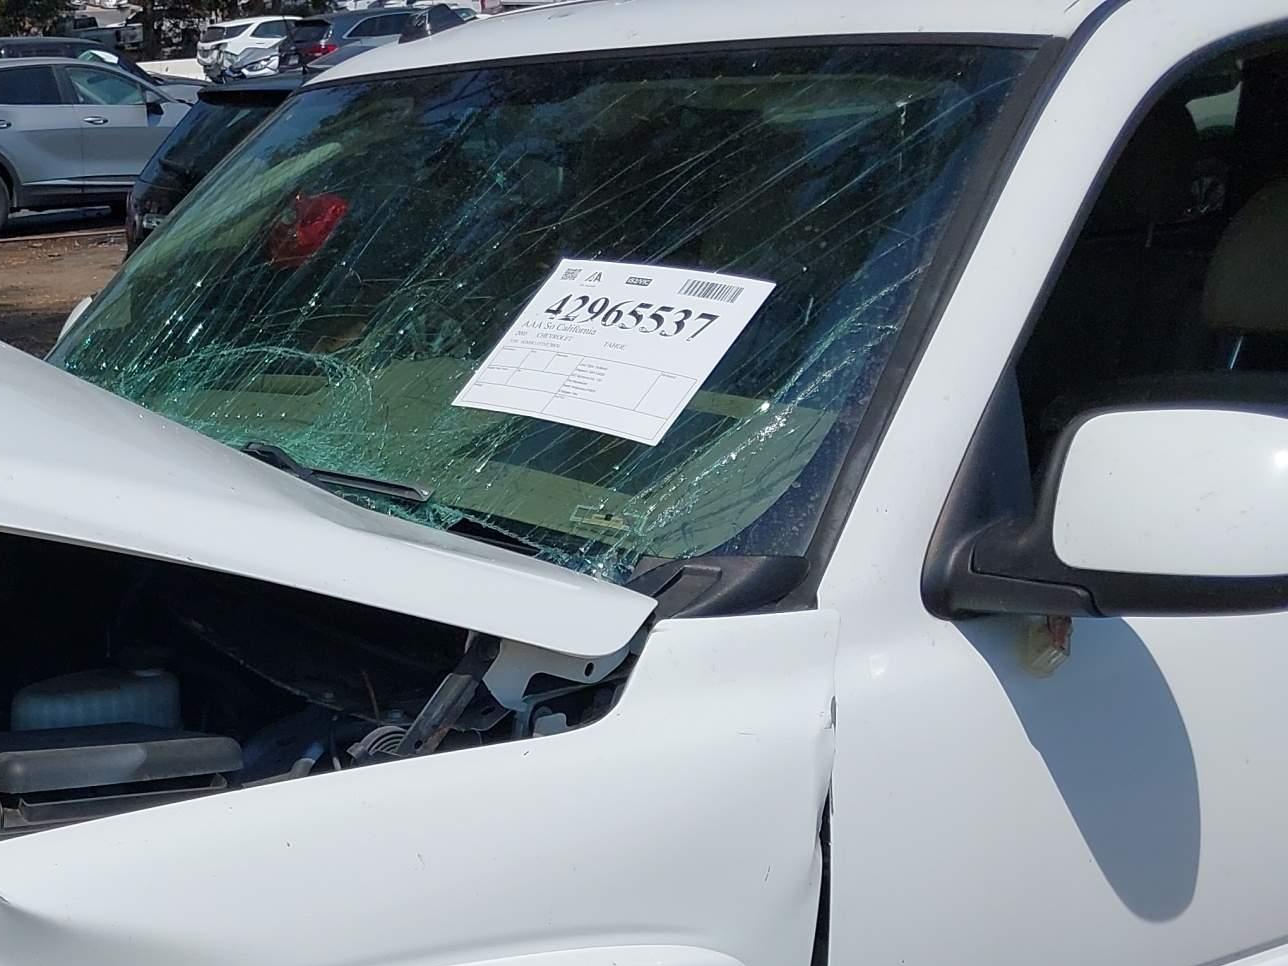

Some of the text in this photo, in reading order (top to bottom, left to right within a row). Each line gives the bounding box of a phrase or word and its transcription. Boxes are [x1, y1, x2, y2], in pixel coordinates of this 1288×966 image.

[521, 320, 597, 336] AAA So California
[544, 294, 720, 342] 42965537
